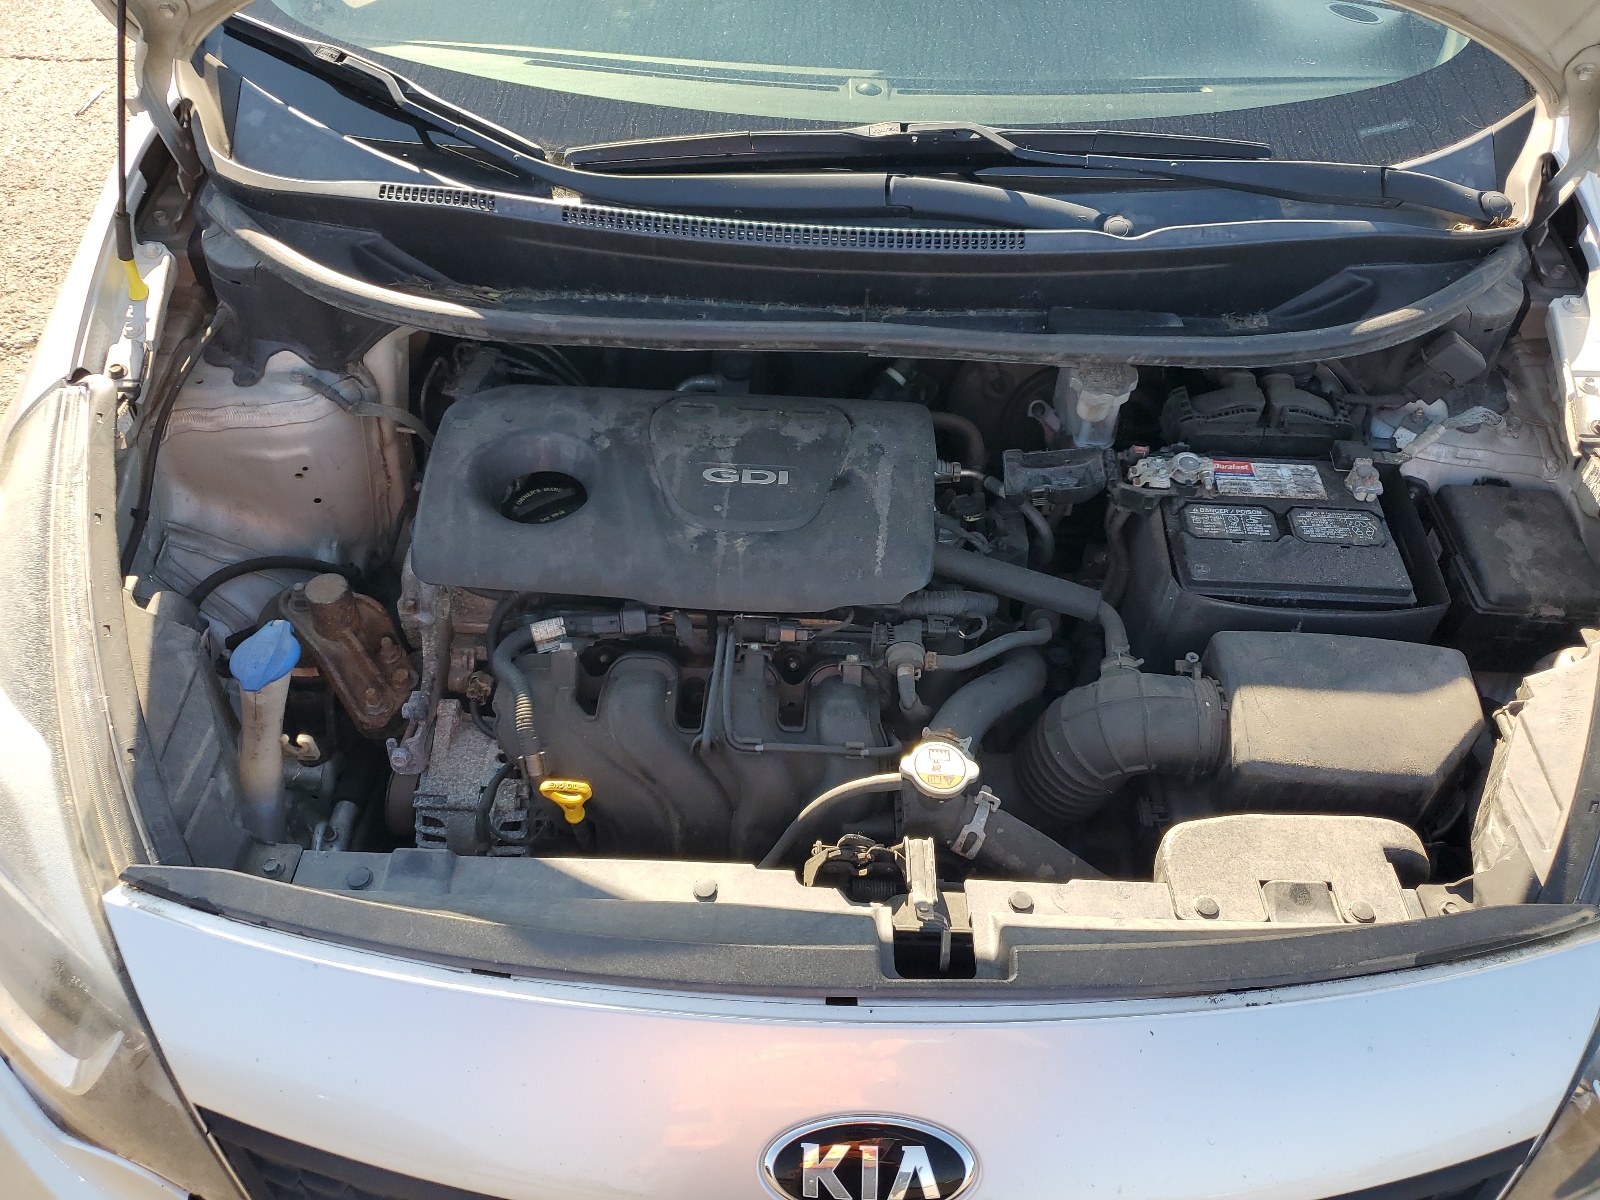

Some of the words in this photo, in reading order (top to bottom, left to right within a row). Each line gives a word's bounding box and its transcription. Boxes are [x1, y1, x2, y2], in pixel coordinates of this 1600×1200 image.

[702, 467, 789, 485] GDI
[1214, 463, 1250, 471] Duralast
[801, 1142, 941, 1200] KIA
